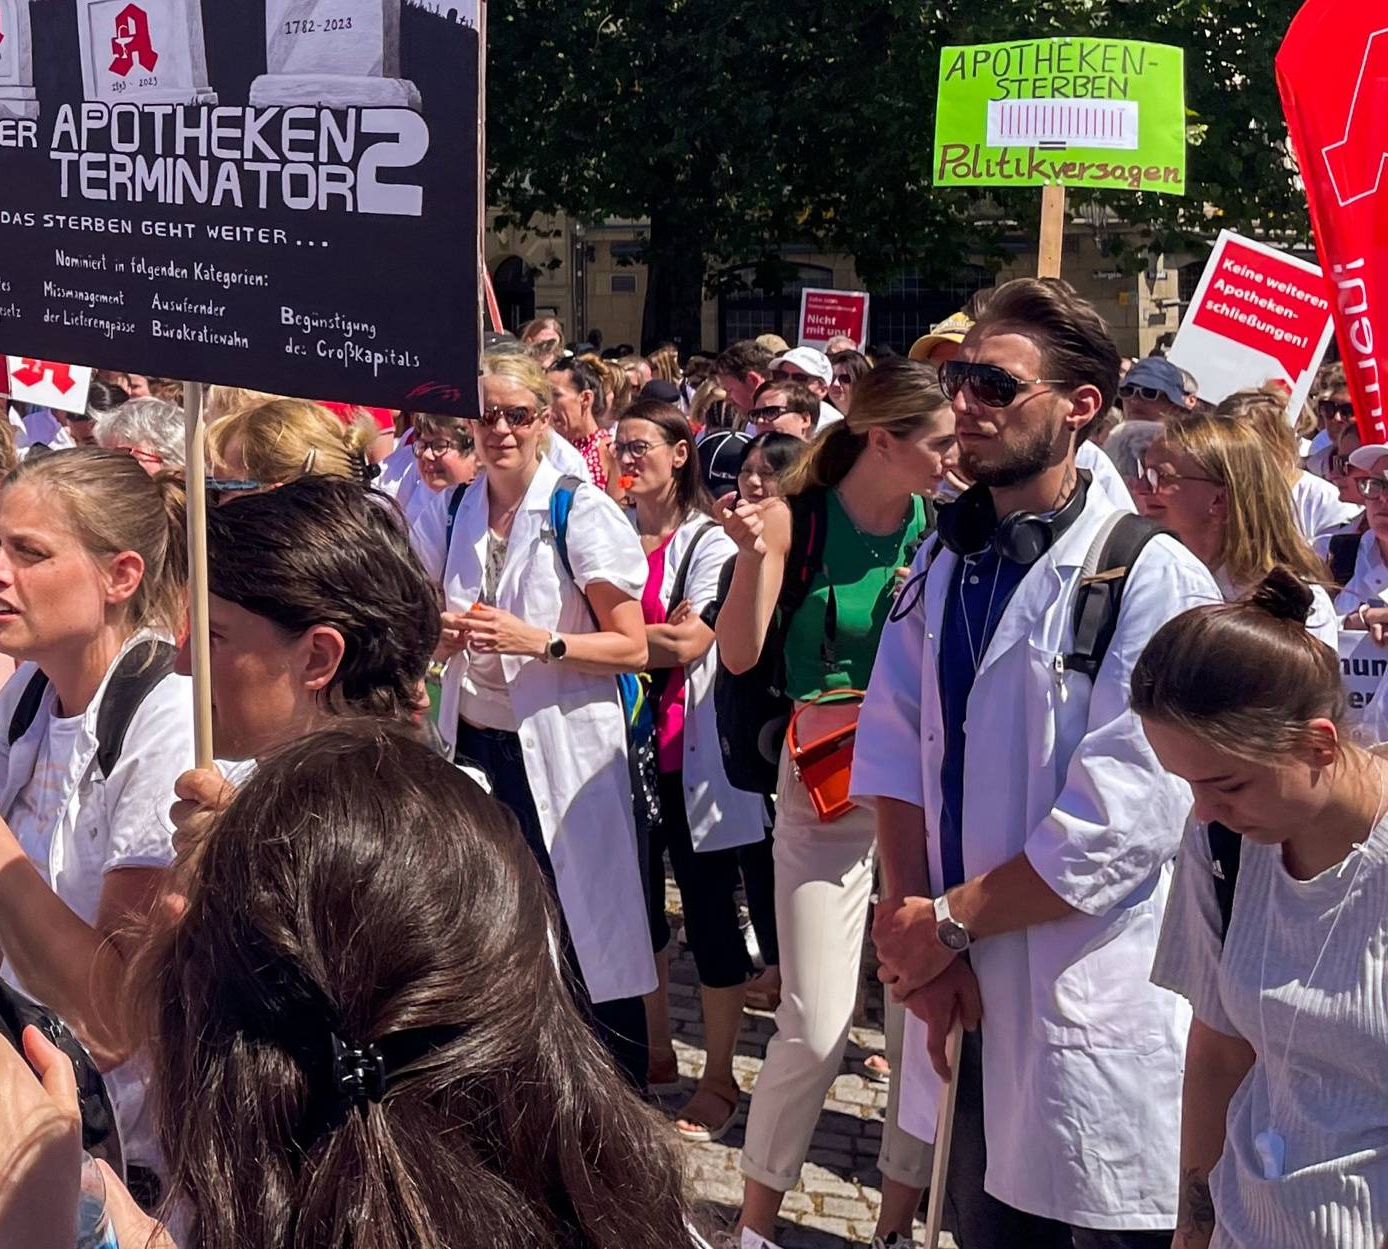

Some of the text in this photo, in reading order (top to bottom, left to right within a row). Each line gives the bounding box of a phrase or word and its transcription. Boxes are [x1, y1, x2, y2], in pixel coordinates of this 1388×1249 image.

[285, 17, 352, 34] 1782-2023
[945, 43, 1159, 82] APOTHEKEN-
[989, 75, 1128, 101] STERBEN
[50, 103, 356, 163] APOTHEKEN
[49, 107, 430, 217] TERMINATOR 2
[938, 143, 1182, 189] Politikversagen
[1, 211, 35, 227] DAS
[43, 214, 132, 235] STERBEN
[141, 221, 196, 239] GEHT
[207, 225, 288, 245] WEITER
[55, 249, 269, 289] Nominiert in folgenden Kategorien:
[1222, 258, 1329, 310] Keine weiteren
[44, 281, 124, 308] Missmanagement
[151, 292, 226, 317] Ausufernder
[1213, 277, 1299, 319] Apotheken-
[44, 308, 60, 323] der
[806, 326, 825, 335] mit
[807, 313, 836, 325] Nicht
[1205, 300, 1309, 349] schließungen!
